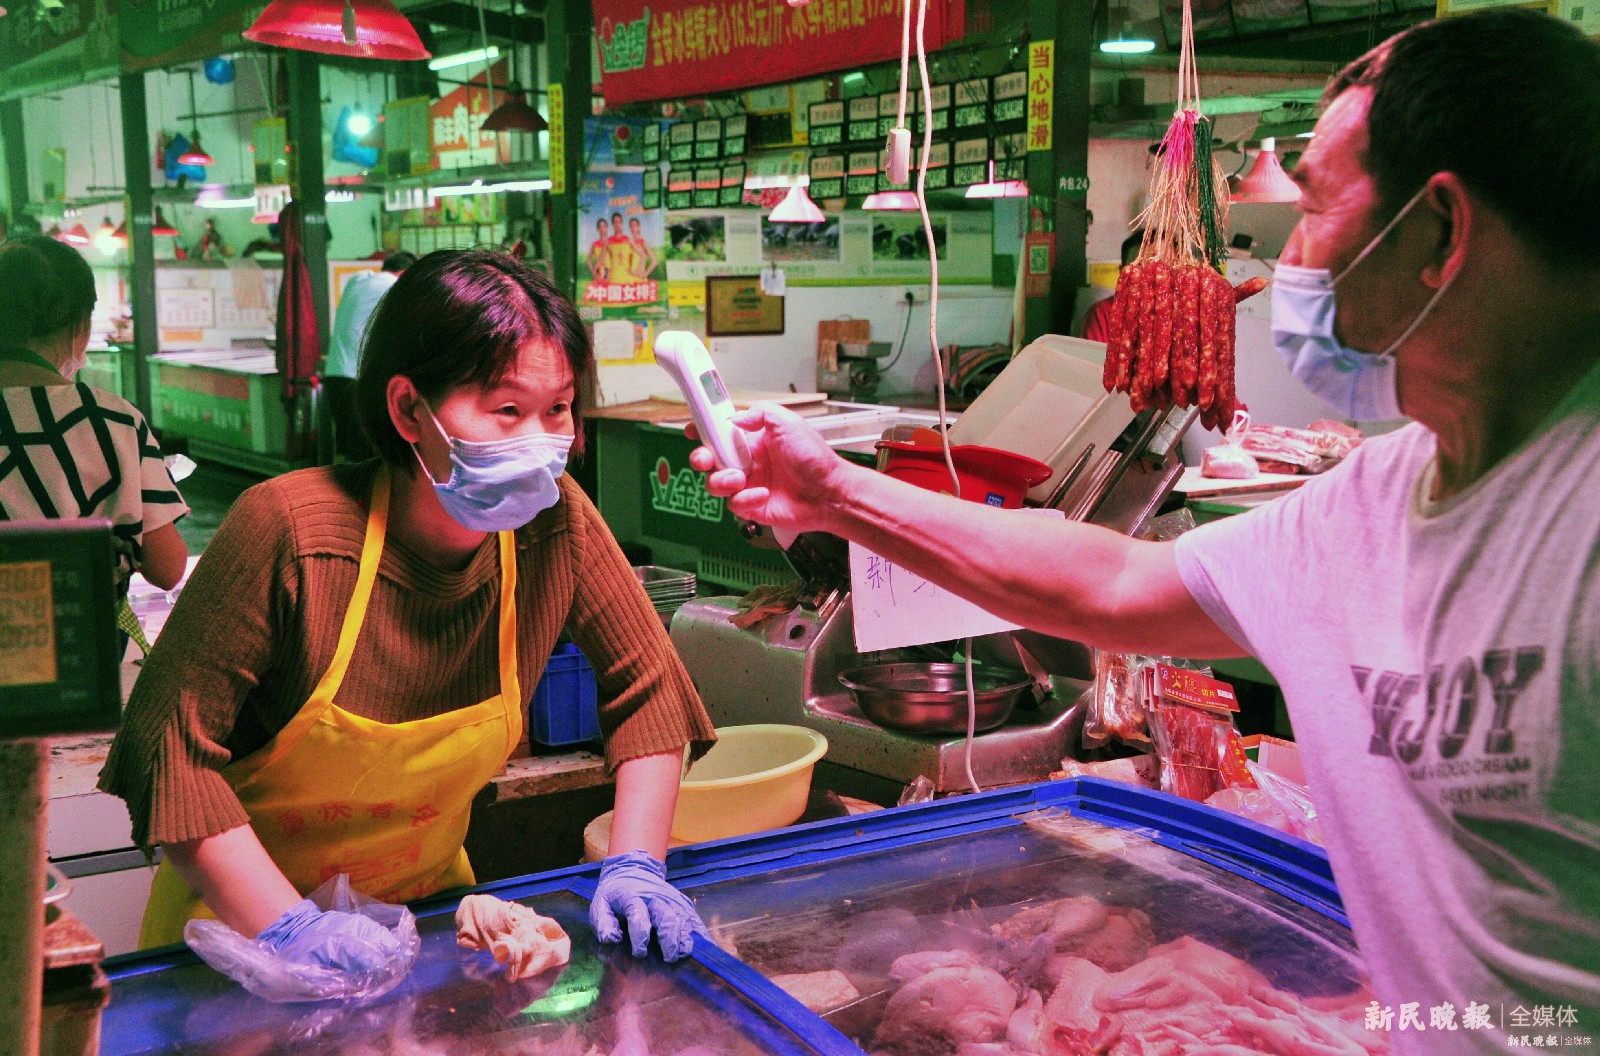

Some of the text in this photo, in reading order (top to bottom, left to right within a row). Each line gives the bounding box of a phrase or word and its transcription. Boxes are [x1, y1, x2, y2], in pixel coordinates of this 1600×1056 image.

[1031, 45, 1051, 147] 当心地滑
[1171, 671, 1216, 698] 火腿 切片
